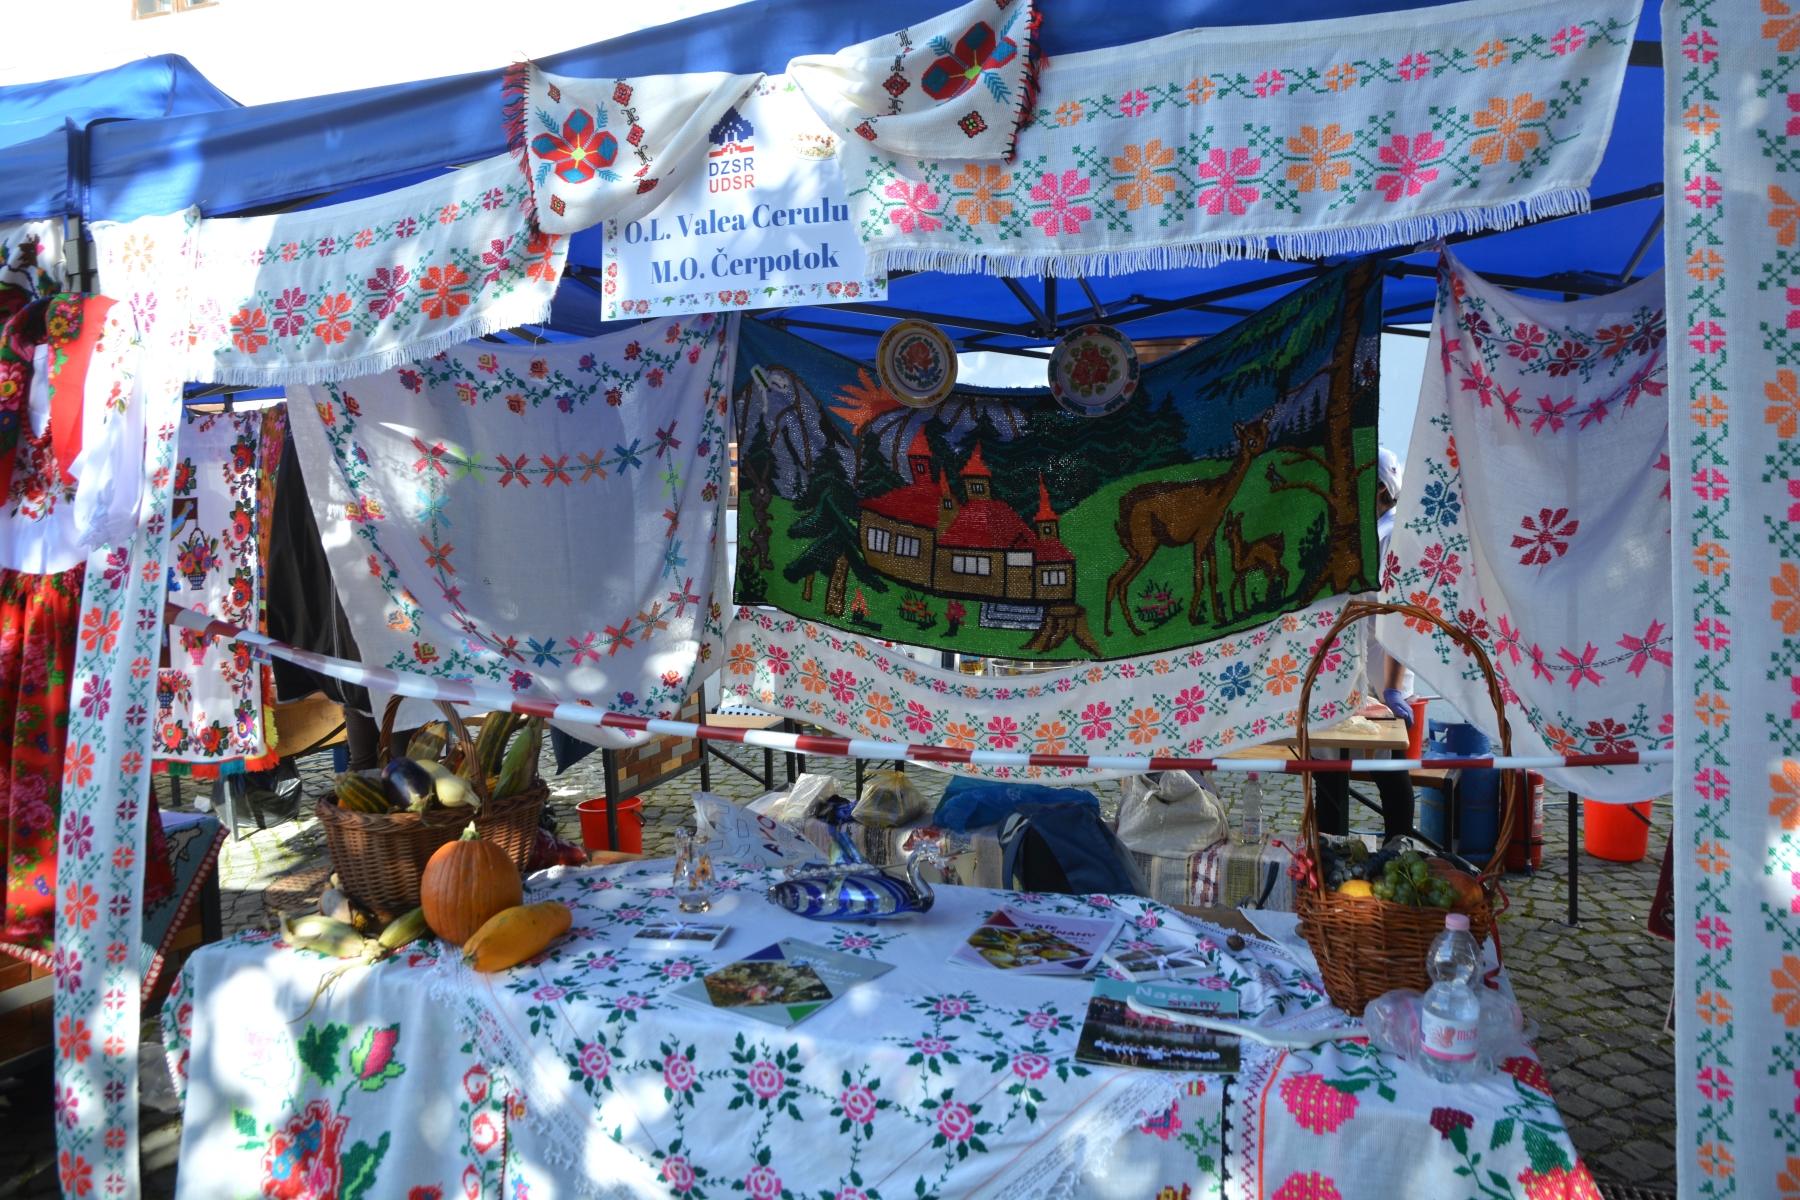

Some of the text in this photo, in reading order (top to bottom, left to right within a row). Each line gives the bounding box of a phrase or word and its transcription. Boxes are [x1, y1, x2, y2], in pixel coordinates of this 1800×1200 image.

[708, 157, 755, 177] DZSR
[708, 174, 755, 193] UDSR
[624, 197, 849, 245] O.L. Valea Cerulu
[651, 243, 839, 284] M.O. Čerpotok
[1135, 985, 1194, 1001] Naše
